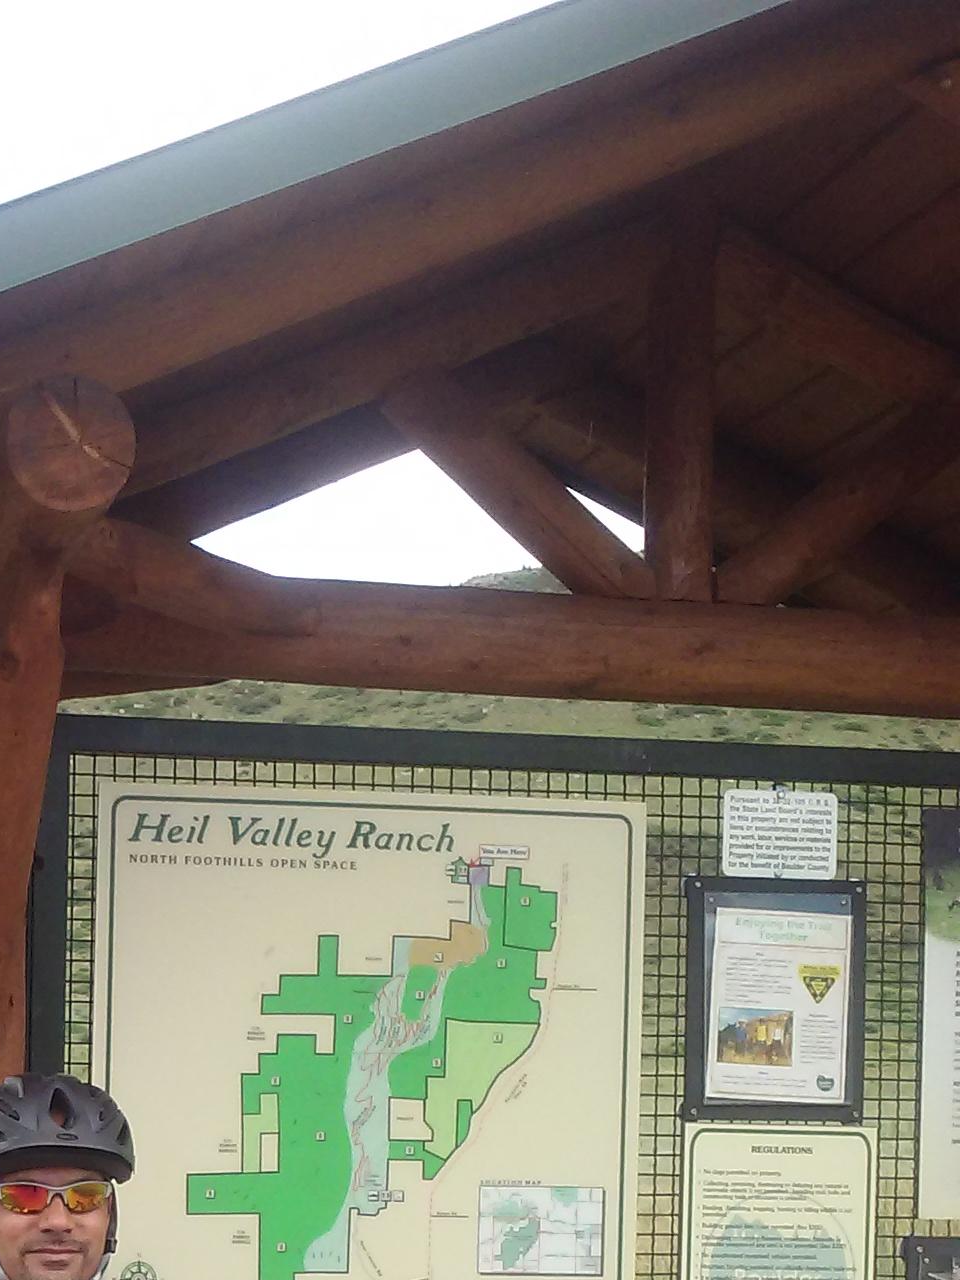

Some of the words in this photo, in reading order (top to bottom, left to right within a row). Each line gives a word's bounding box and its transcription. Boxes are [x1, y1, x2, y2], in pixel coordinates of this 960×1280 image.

[127, 813, 210, 845] Heil
[227, 815, 337, 859] Valley
[346, 820, 456, 853] Ranch
[129, 854, 178, 865] NORTH
[184, 855, 264, 868] FOOTHILLS
[270, 858, 308, 869] OPEN
[313, 859, 358, 871] SPACE
[751, 1145, 813, 1155] REGULATIONS
